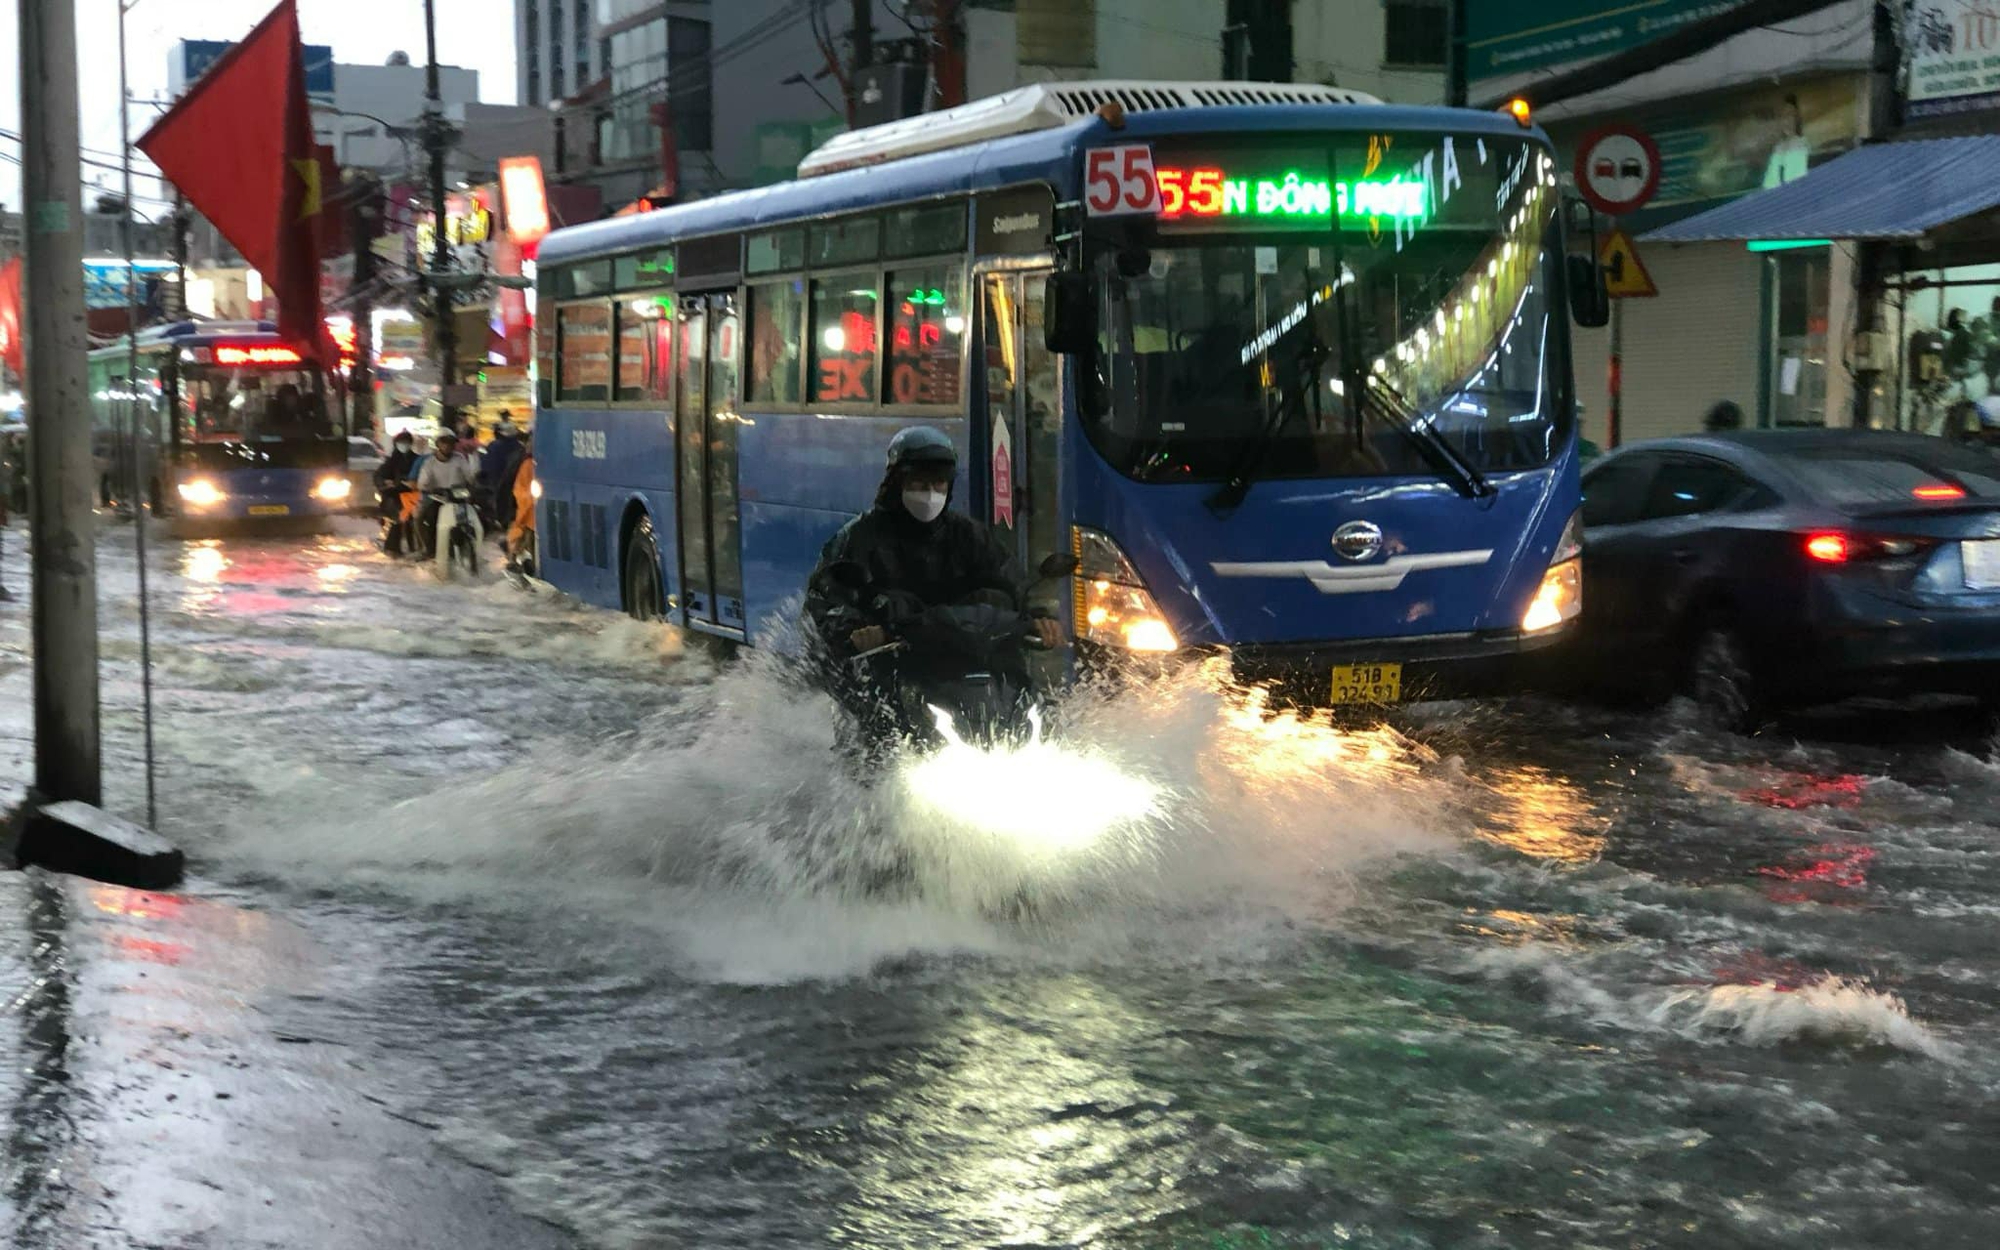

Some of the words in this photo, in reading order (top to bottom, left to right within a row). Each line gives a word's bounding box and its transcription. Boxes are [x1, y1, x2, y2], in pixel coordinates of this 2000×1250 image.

[1088, 149, 1155, 212] 55
[1156, 170, 1223, 213] 55
[1352, 668, 1382, 684] 51B
